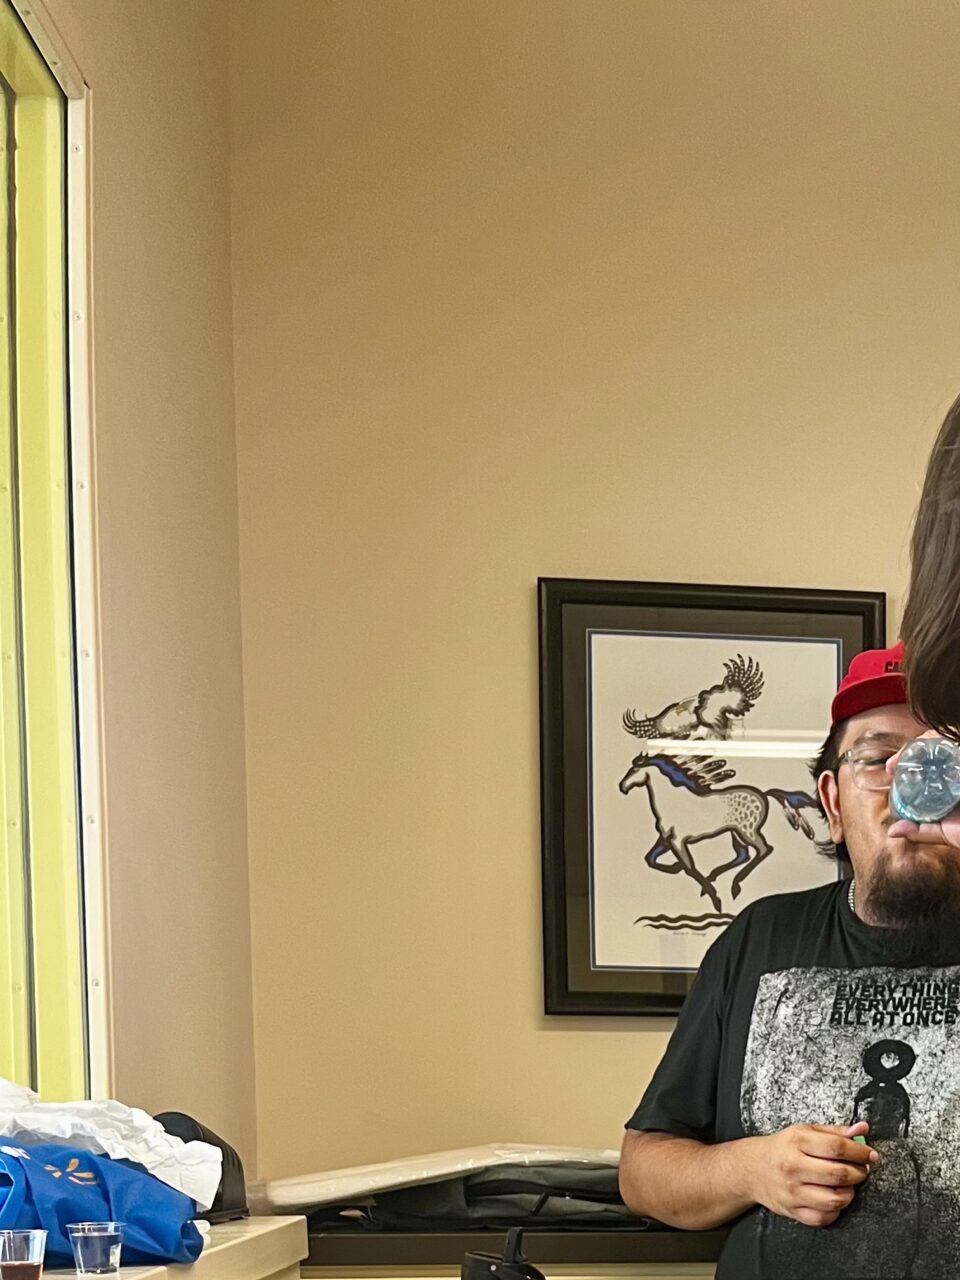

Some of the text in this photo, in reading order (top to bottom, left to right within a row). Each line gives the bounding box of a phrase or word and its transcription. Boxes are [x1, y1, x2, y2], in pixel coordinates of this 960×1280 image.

[835, 981, 960, 998] EVERYTHING
[833, 997, 958, 1011] EVERYWHERE
[829, 1010, 958, 1027] ALL AT ONCE
